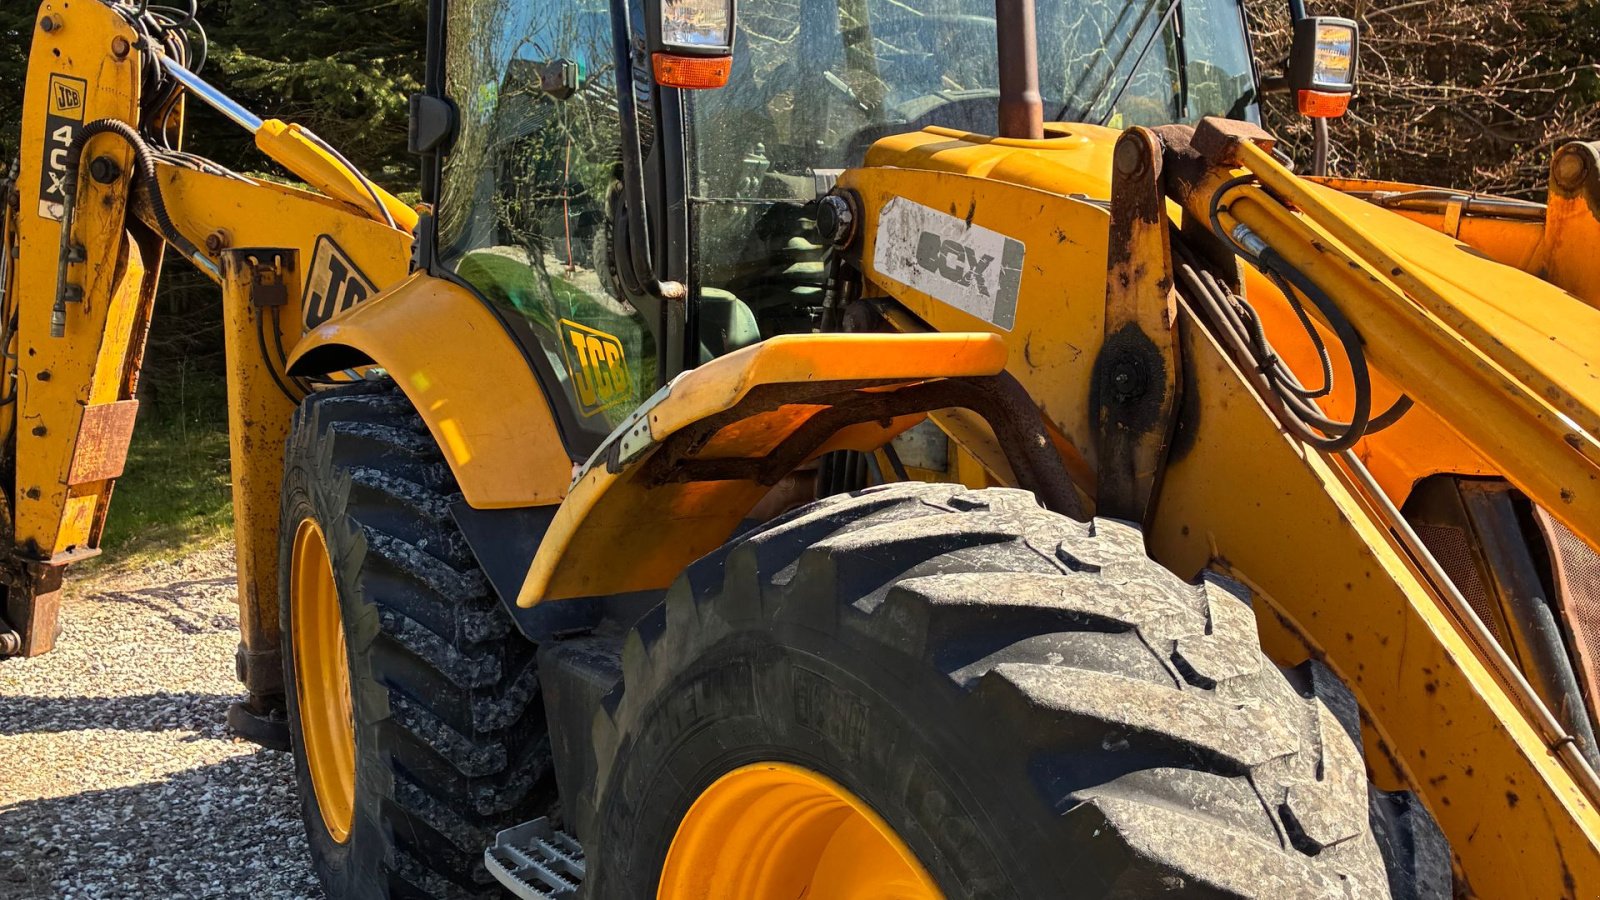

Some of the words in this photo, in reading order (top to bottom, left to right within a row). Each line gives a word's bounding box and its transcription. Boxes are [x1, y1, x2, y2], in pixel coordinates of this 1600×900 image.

[58, 85, 79, 108] JCB
[46, 125, 73, 196] 4CX
[569, 330, 628, 407] JCB
